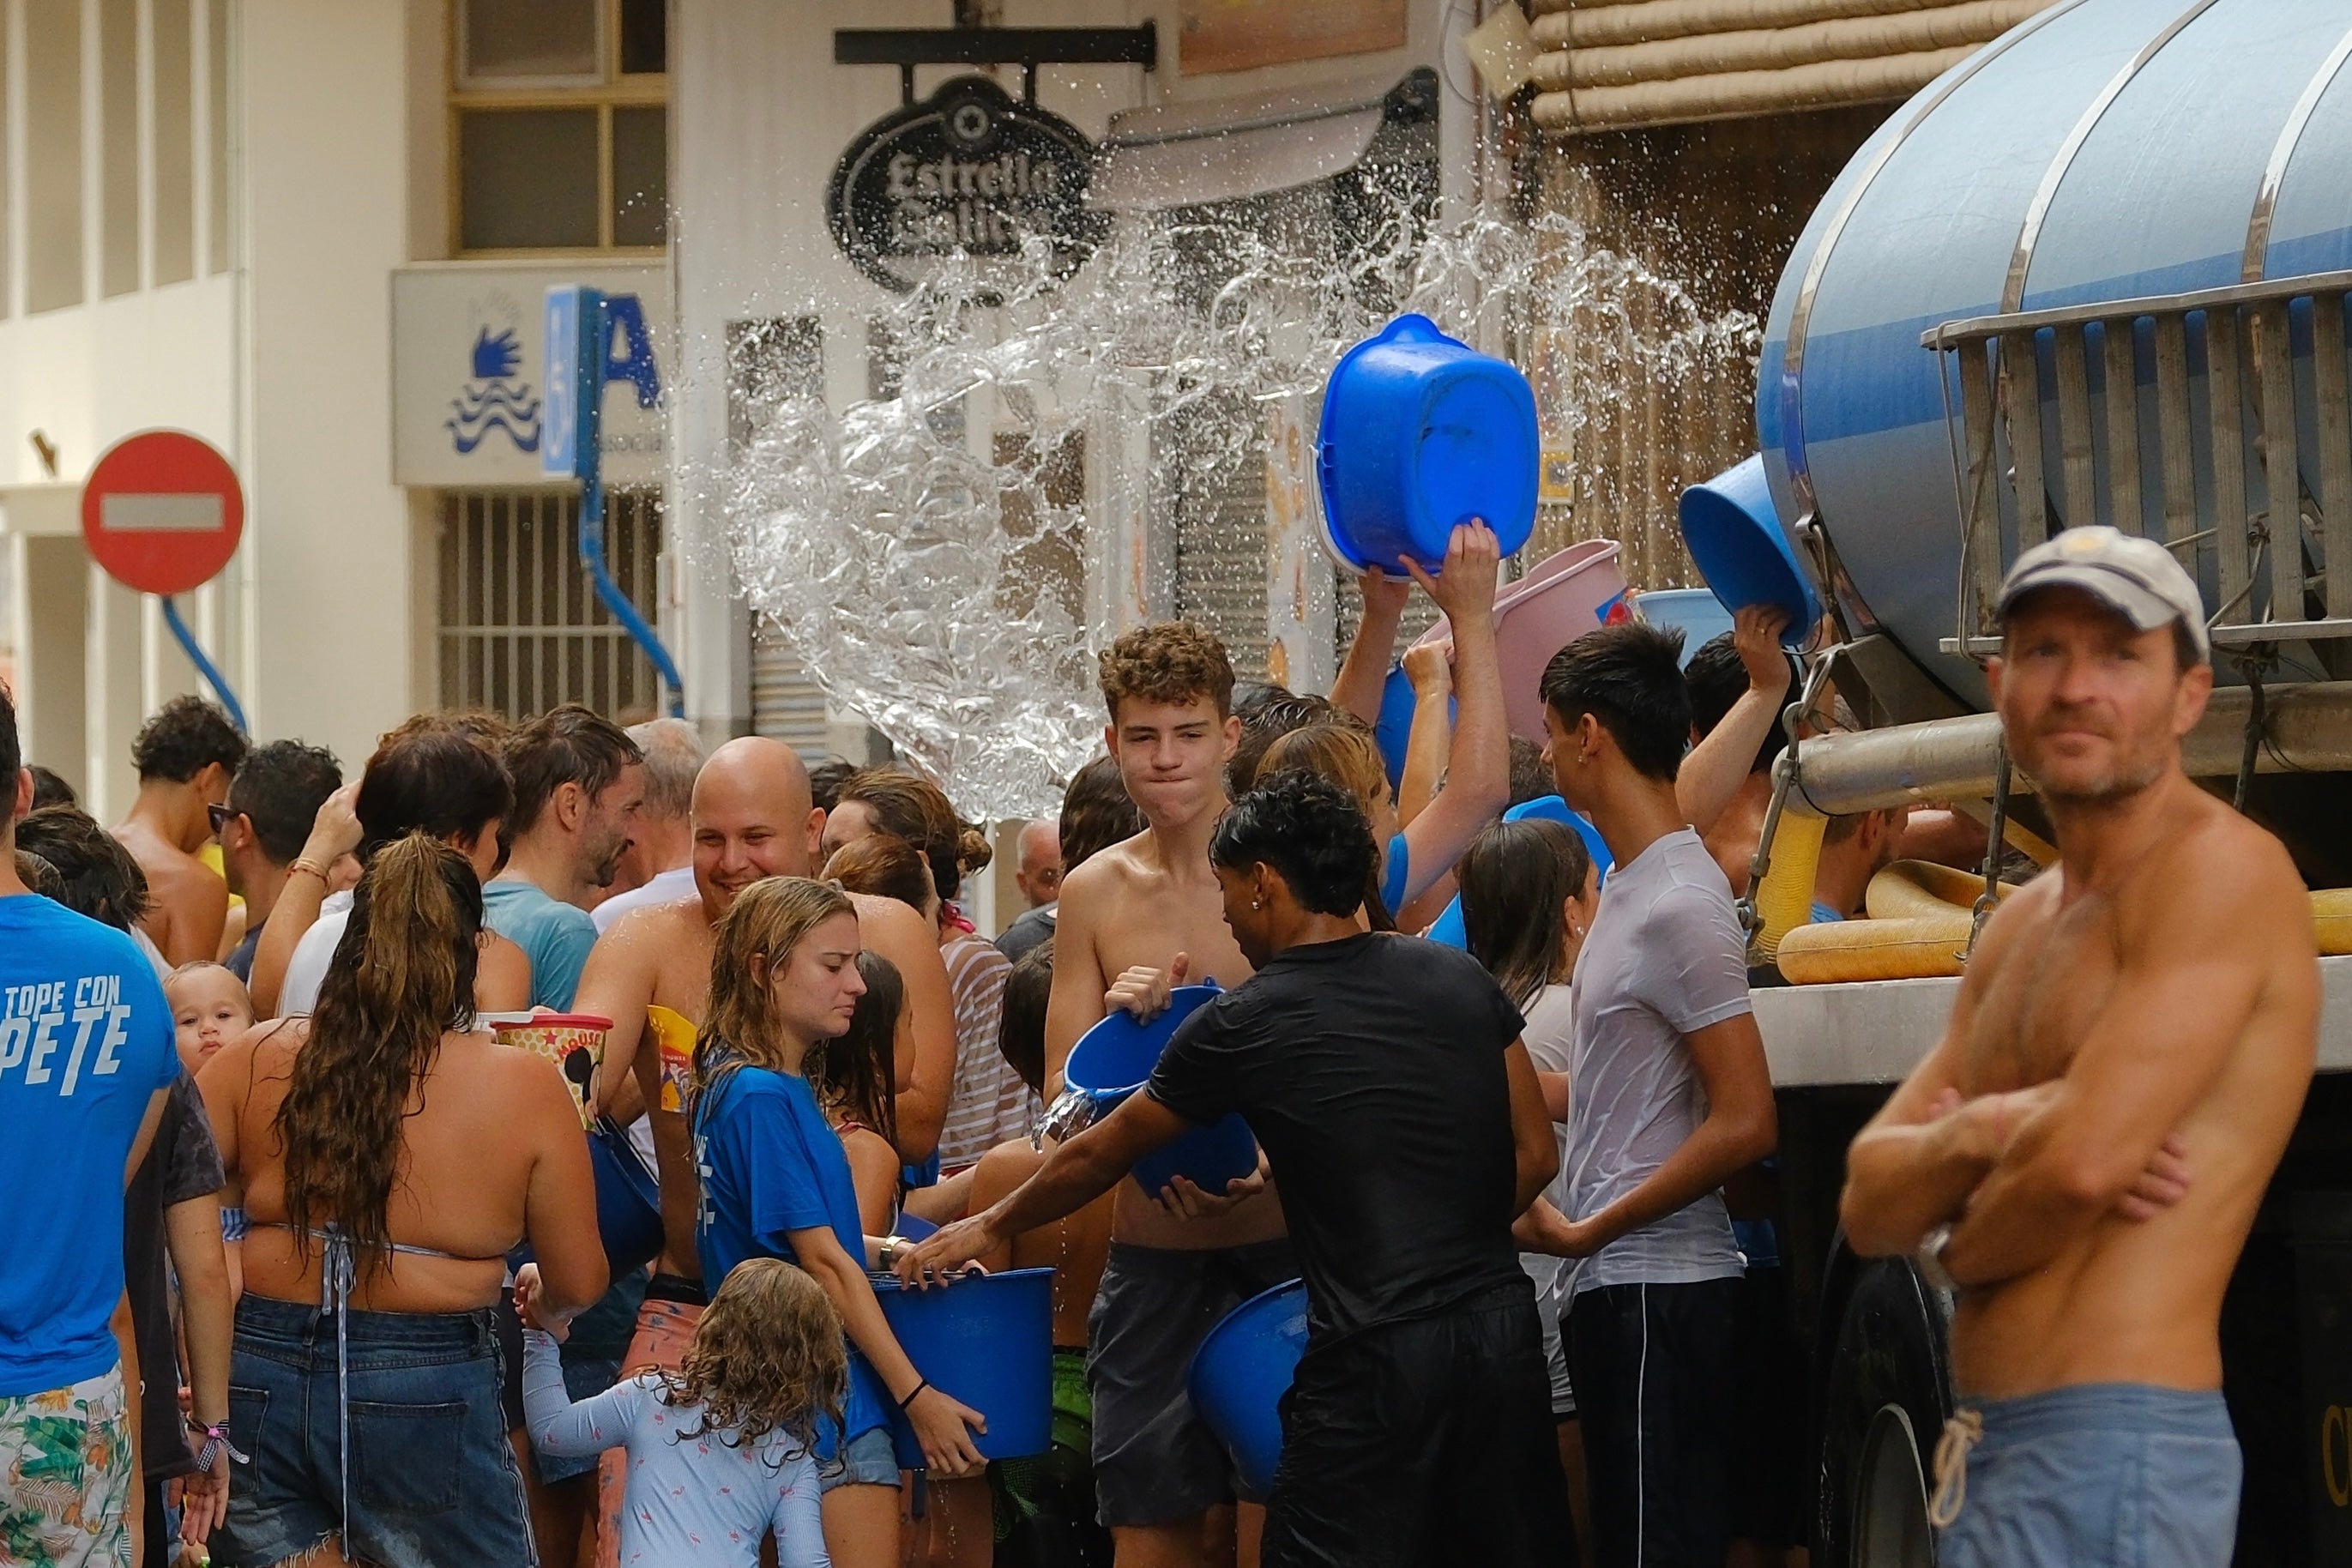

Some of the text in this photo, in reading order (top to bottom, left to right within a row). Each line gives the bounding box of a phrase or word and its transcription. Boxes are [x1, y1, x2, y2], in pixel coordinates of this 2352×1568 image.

[885, 152, 1060, 199] Estrella
[5, 974, 120, 1022] TOPE CON
[557, 1031, 601, 1061] MOUSE
